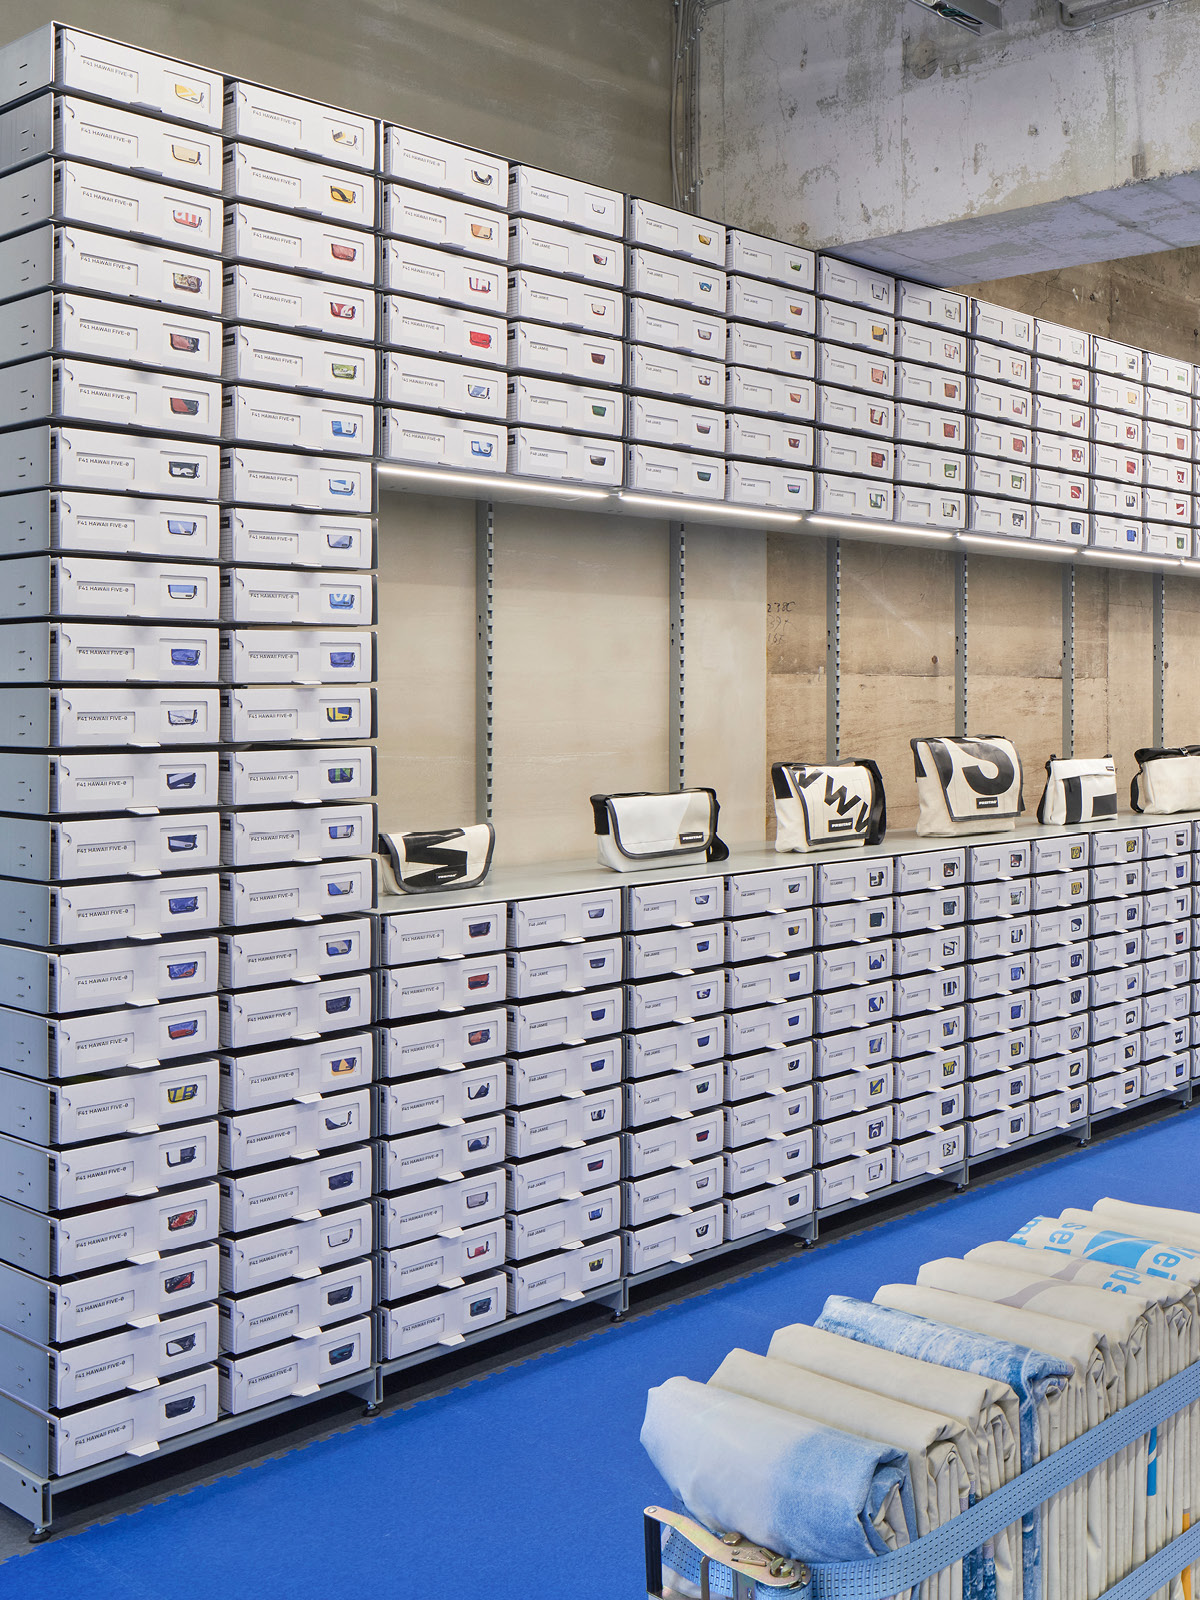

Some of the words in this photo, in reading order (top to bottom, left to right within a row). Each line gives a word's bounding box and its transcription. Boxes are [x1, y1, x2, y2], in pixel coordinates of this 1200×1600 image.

[94, 63, 114, 73] HAWAII
[92, 130, 112, 139] HAWAII
[93, 194, 113, 202] HAWAII
[92, 258, 112, 267] HAWAII
[87, 1170, 107, 1178] HAWAII
[88, 1237, 108, 1246] HAWAII
[85, 1301, 105, 1311] HAWAII
[86, 1366, 106, 1376] HAWAII
[86, 1431, 106, 1442] HAWAII
